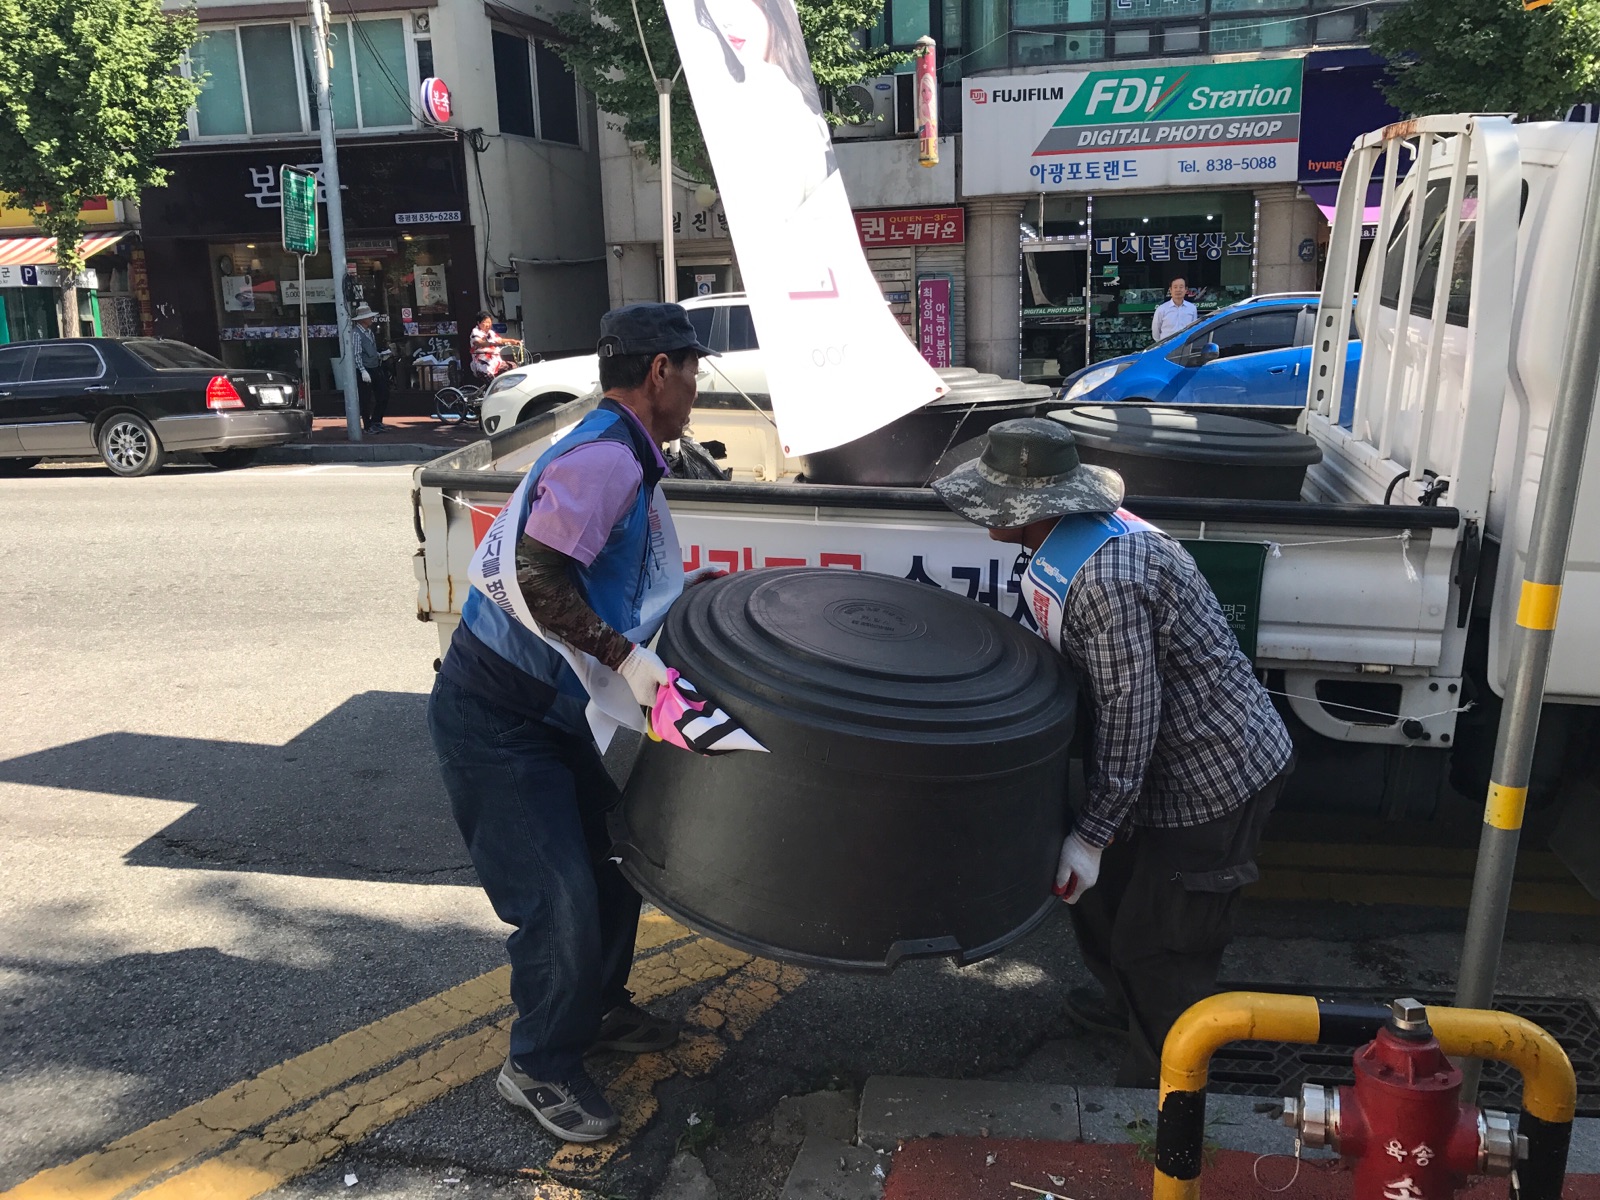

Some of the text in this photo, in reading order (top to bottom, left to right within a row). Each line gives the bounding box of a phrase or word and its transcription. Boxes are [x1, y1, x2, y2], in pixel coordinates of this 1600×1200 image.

[992, 87, 1063, 103] FUJIFILM
[1077, 120, 1283, 147] DIGITAL PHOTO SHOP
[1029, 159, 1139, 185] 아광포토랜드
[1177, 156, 1277, 174] Tel. 838-5088
[418, 212, 460, 222] 836-6288
[861, 217, 886, 242] 퀸
[889, 215, 922, 223] QUEEN
[889, 221, 957, 240] 노래타운
[1095, 231, 1252, 263] 디지털현상소
[923, 287, 933, 320] 최상의
[935, 303, 946, 336] 아늑한
